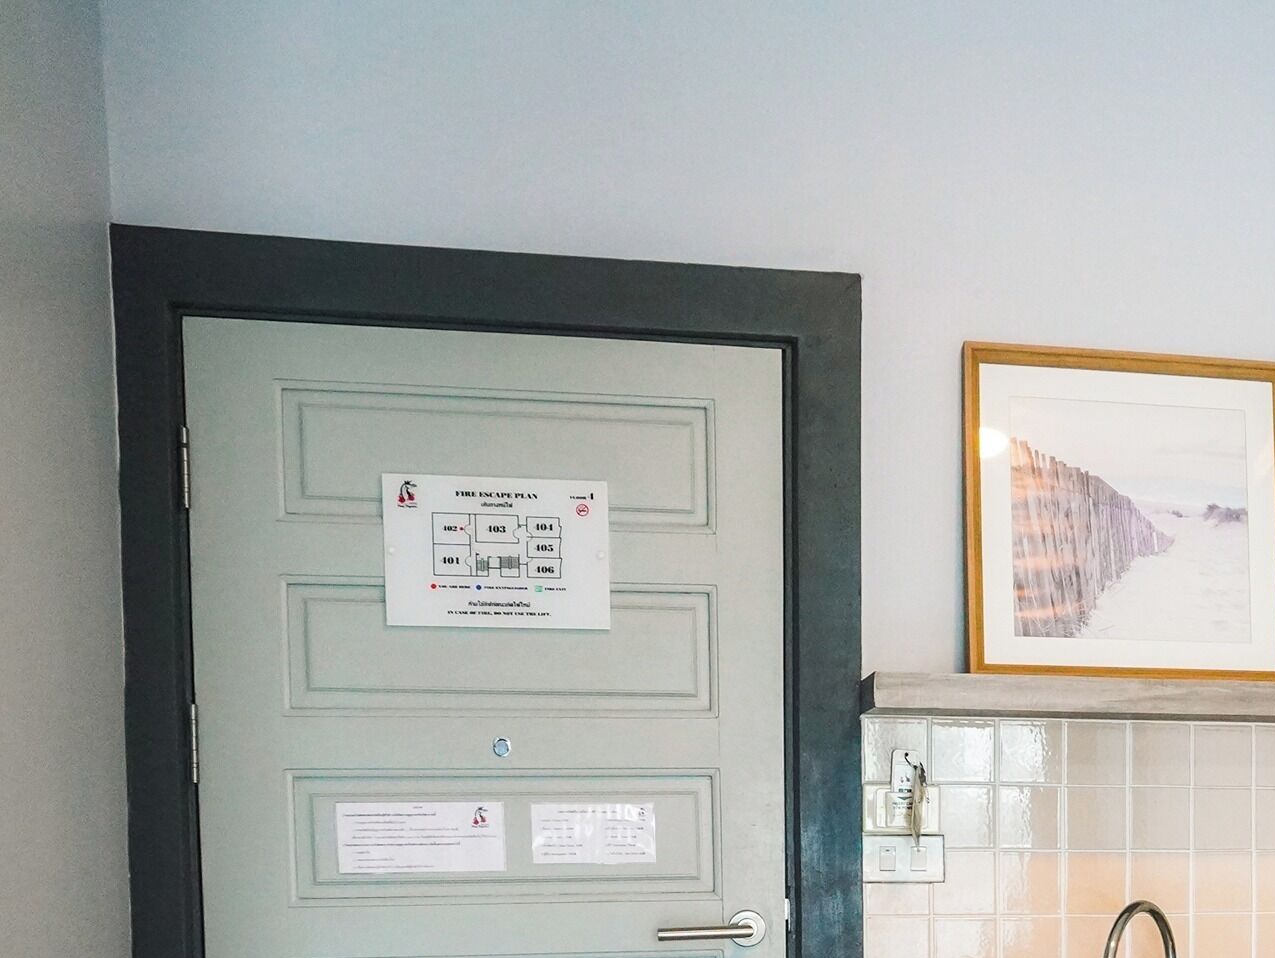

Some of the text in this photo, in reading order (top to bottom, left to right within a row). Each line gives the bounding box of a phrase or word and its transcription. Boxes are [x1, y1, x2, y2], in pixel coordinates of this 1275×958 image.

[455, 490, 539, 500] FIRE ESCAPE PLAN
[486, 525, 507, 533] 403
[534, 523, 554, 531] 404
[534, 543, 554, 552] 405
[441, 556, 460, 565] 401
[534, 565, 555, 574] 406
